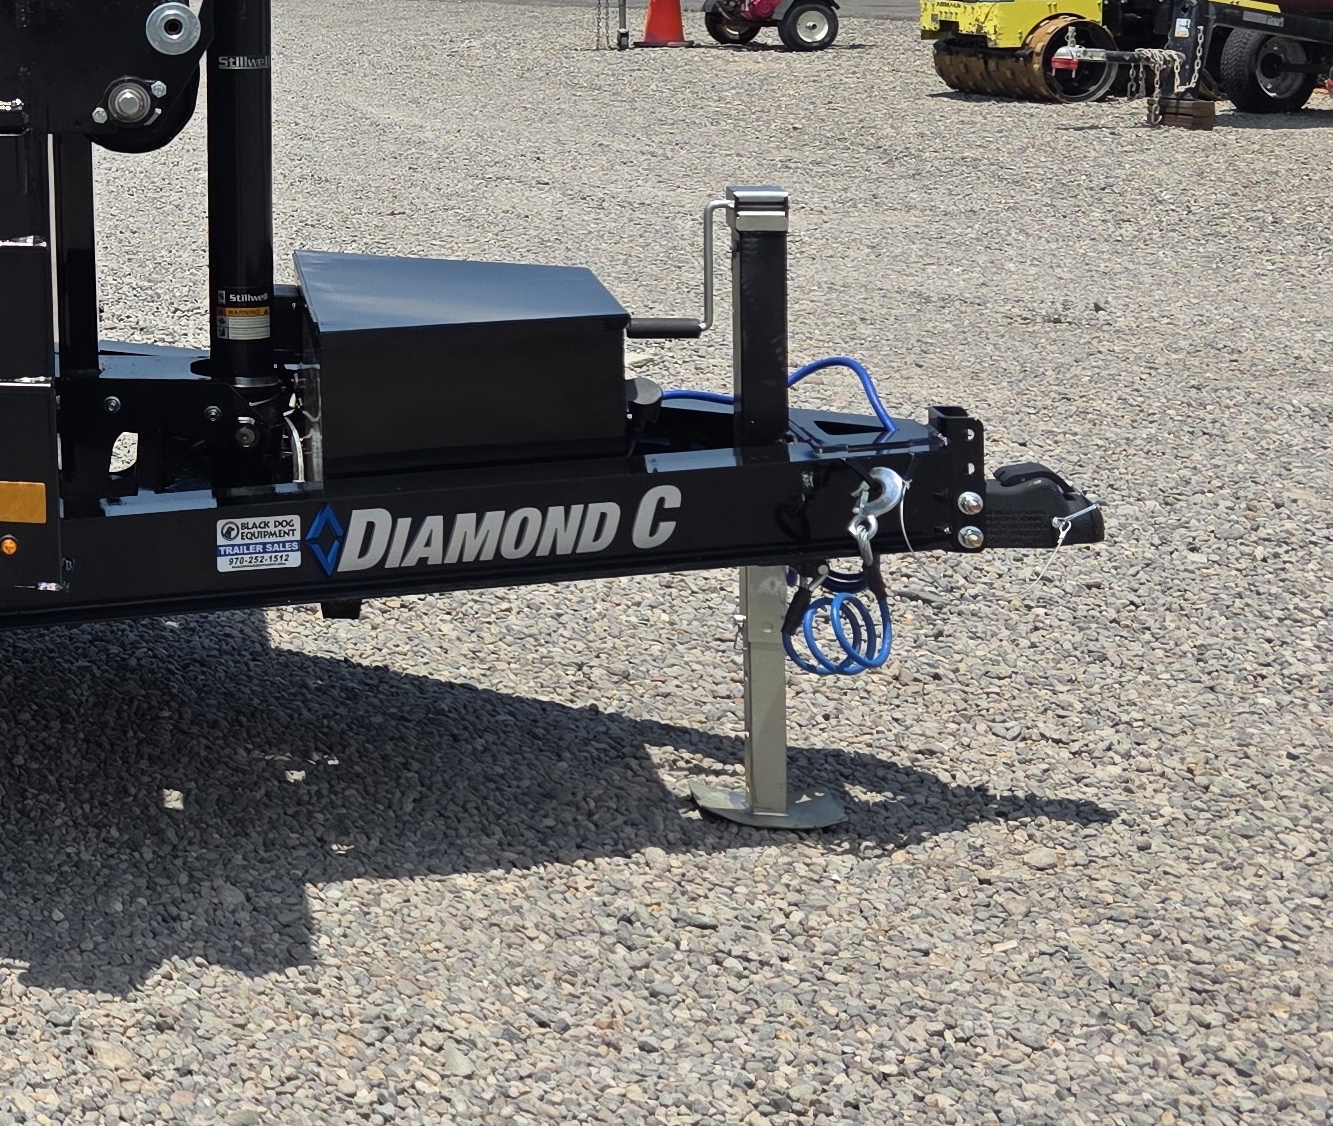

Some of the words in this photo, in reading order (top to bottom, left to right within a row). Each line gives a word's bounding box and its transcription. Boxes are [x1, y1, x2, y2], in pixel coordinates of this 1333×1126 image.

[218, 56, 270, 67] Stillwell
[240, 520, 270, 530] BLACK
[274, 519, 294, 528] DOG
[336, 500, 622, 573] DIAMOND
[632, 484, 683, 550] C
[240, 529, 297, 541] EQUIPMENT
[218, 544, 263, 555] TRAILER
[265, 542, 299, 552] SALES
[228, 554, 290, 565] 970-252-1512
